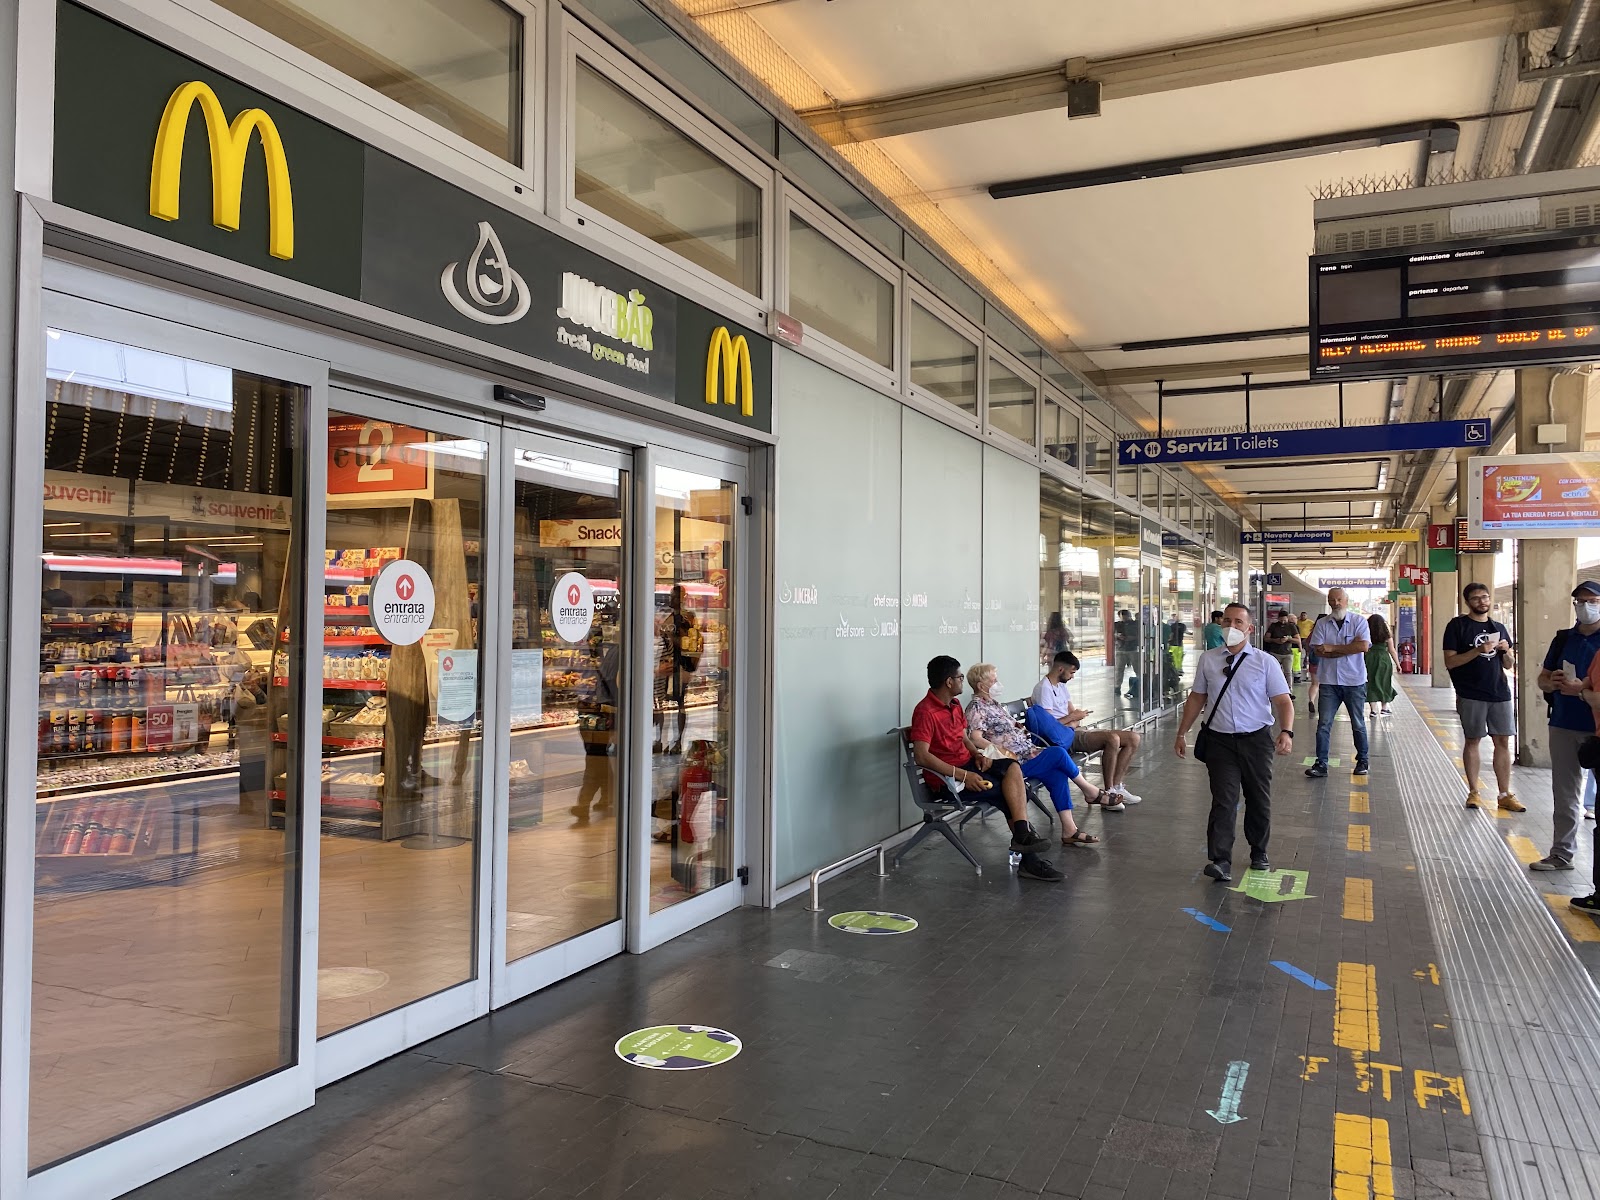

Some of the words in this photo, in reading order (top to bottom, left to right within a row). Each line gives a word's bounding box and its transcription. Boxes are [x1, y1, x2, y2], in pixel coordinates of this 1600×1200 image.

[1409, 252, 1451, 263] destinazione
[1454, 249, 1485, 258] destination
[1320, 264, 1337, 272] treno
[1408, 287, 1439, 297] partenza
[1442, 284, 1469, 293] departure
[1320, 335, 1357, 344] informazioni
[1360, 333, 1389, 341] information
[557, 326, 592, 354] fresh
[592, 342, 625, 362] green
[626, 352, 650, 374] food
[1166, 436, 1228, 454] Servizi
[1233, 434, 1279, 451] Toilets
[43, 482, 116, 505] ouvenir
[208, 500, 277, 521] souvenir
[577, 525, 621, 540] Snack
[1293, 531, 1331, 540] Aeroporto
[1320, 577, 1387, 586] Venezia-Mestre
[873, 594, 886, 607] chef
[886, 597, 899, 607] store
[384, 603, 425, 614] entrata
[559, 606, 587, 617] entrata
[383, 613, 425, 624] entrance
[559, 616, 588, 625] entrance
[836, 623, 850, 638] chef
[850, 627, 864, 637] store
[276, 677, 282, 686] 2
